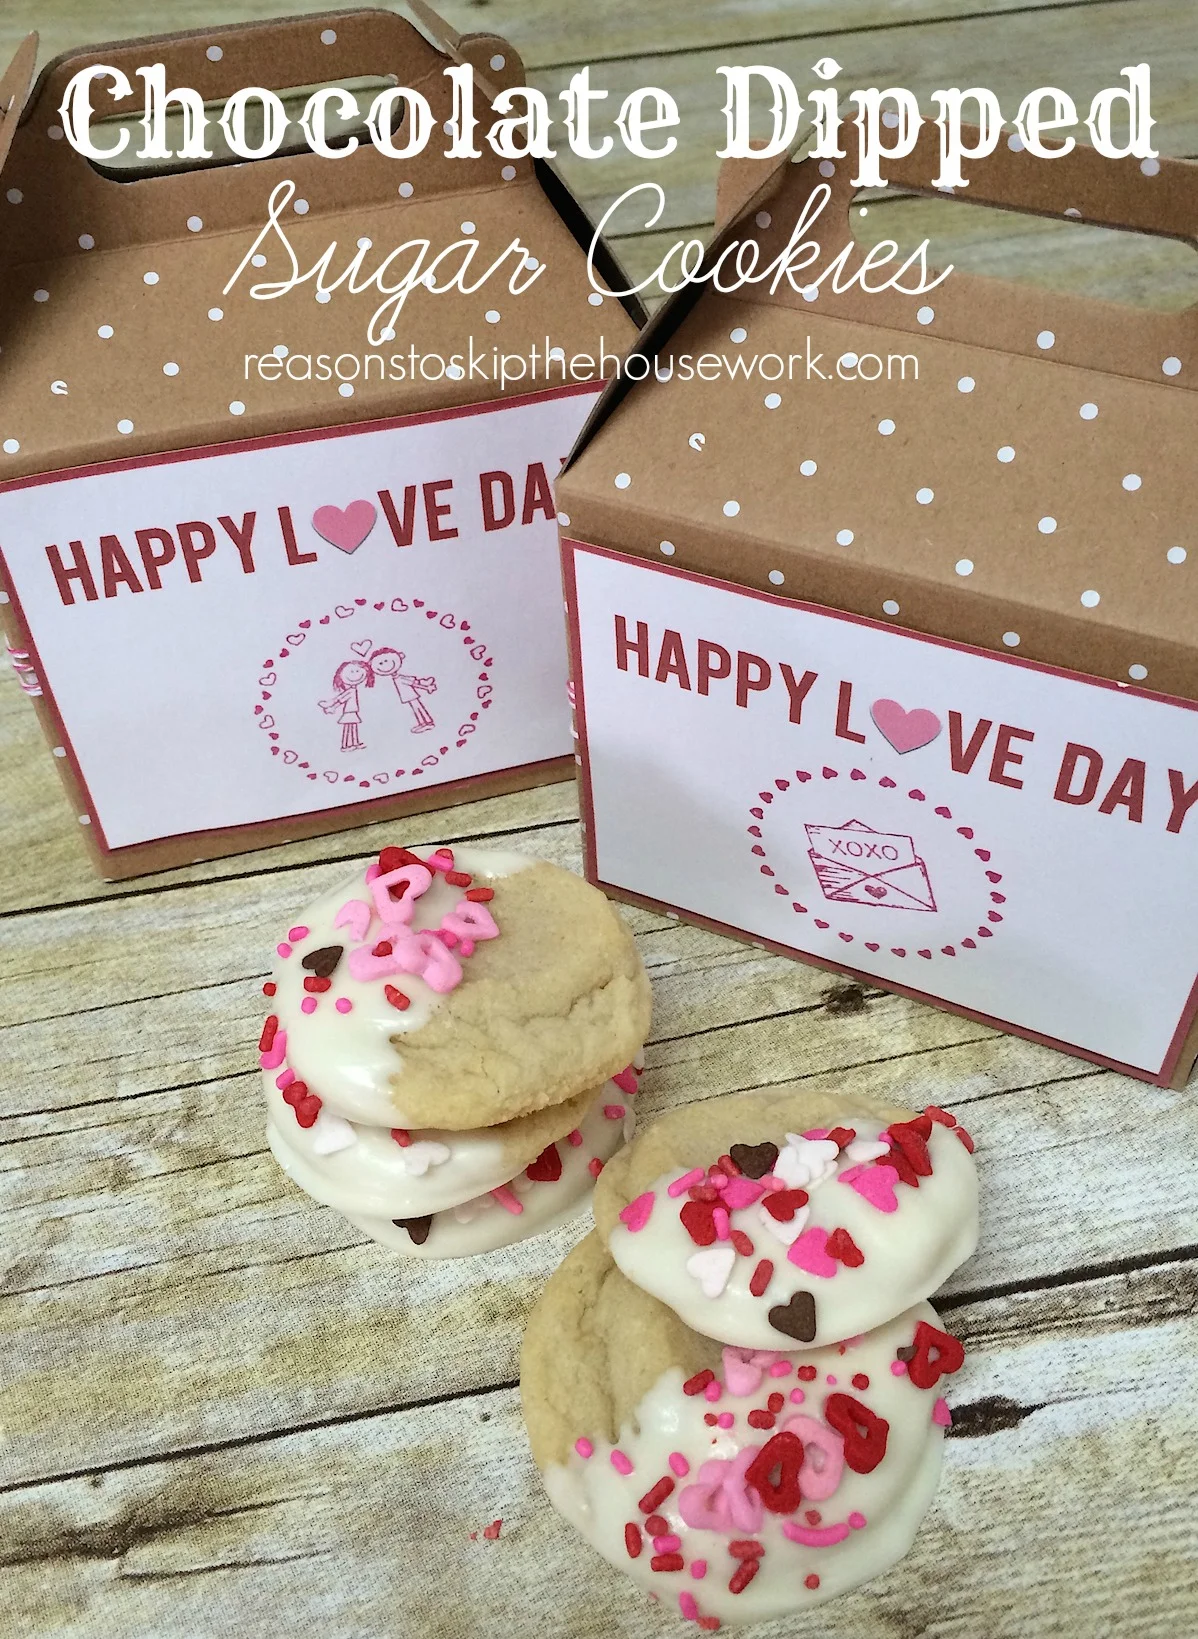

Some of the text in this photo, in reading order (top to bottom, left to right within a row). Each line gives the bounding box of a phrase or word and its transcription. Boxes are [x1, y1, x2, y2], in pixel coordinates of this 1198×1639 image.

[45, 511, 257, 606] HAPPY
[479, 457, 567, 532] DA
[614, 614, 819, 725] HAPPY
[1053, 741, 1198, 834] DAY
[828, 838, 898, 861] XOXO
